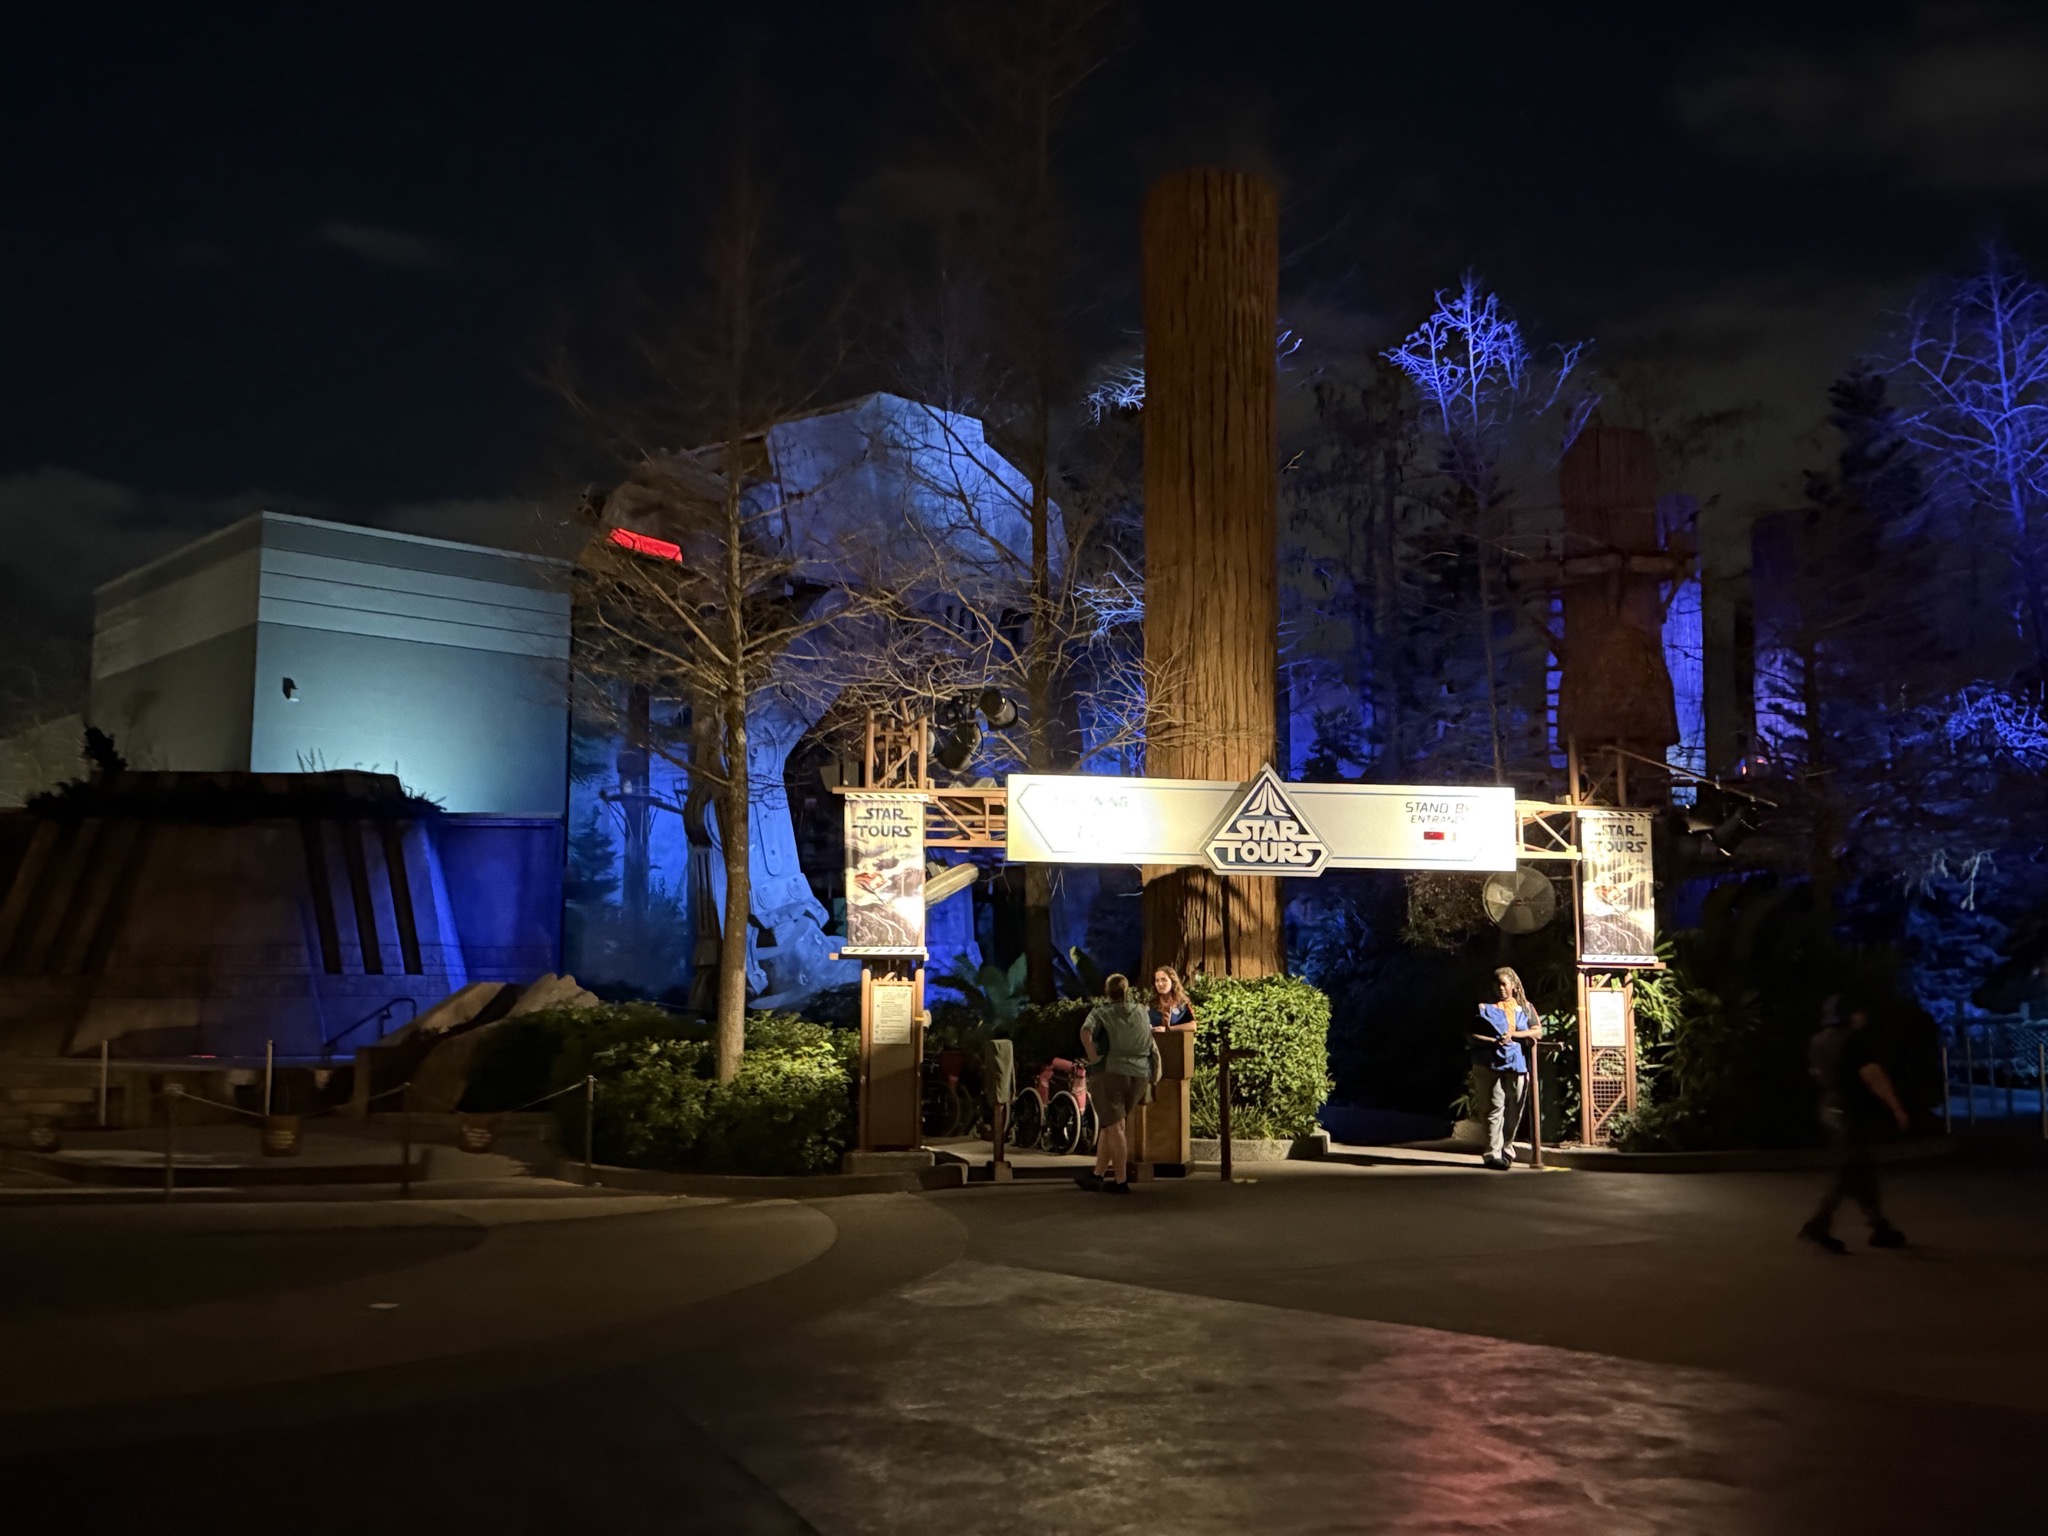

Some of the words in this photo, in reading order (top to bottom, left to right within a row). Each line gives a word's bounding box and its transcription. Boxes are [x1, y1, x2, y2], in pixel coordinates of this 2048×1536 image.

[1405, 801, 1448, 814] STAND
[856, 808, 913, 821] STAR
[1410, 815, 1465, 824] ENTRANC
[852, 825, 917, 837] TOURS
[1215, 820, 1320, 841] STAR
[1206, 841, 1329, 864] TOURS
